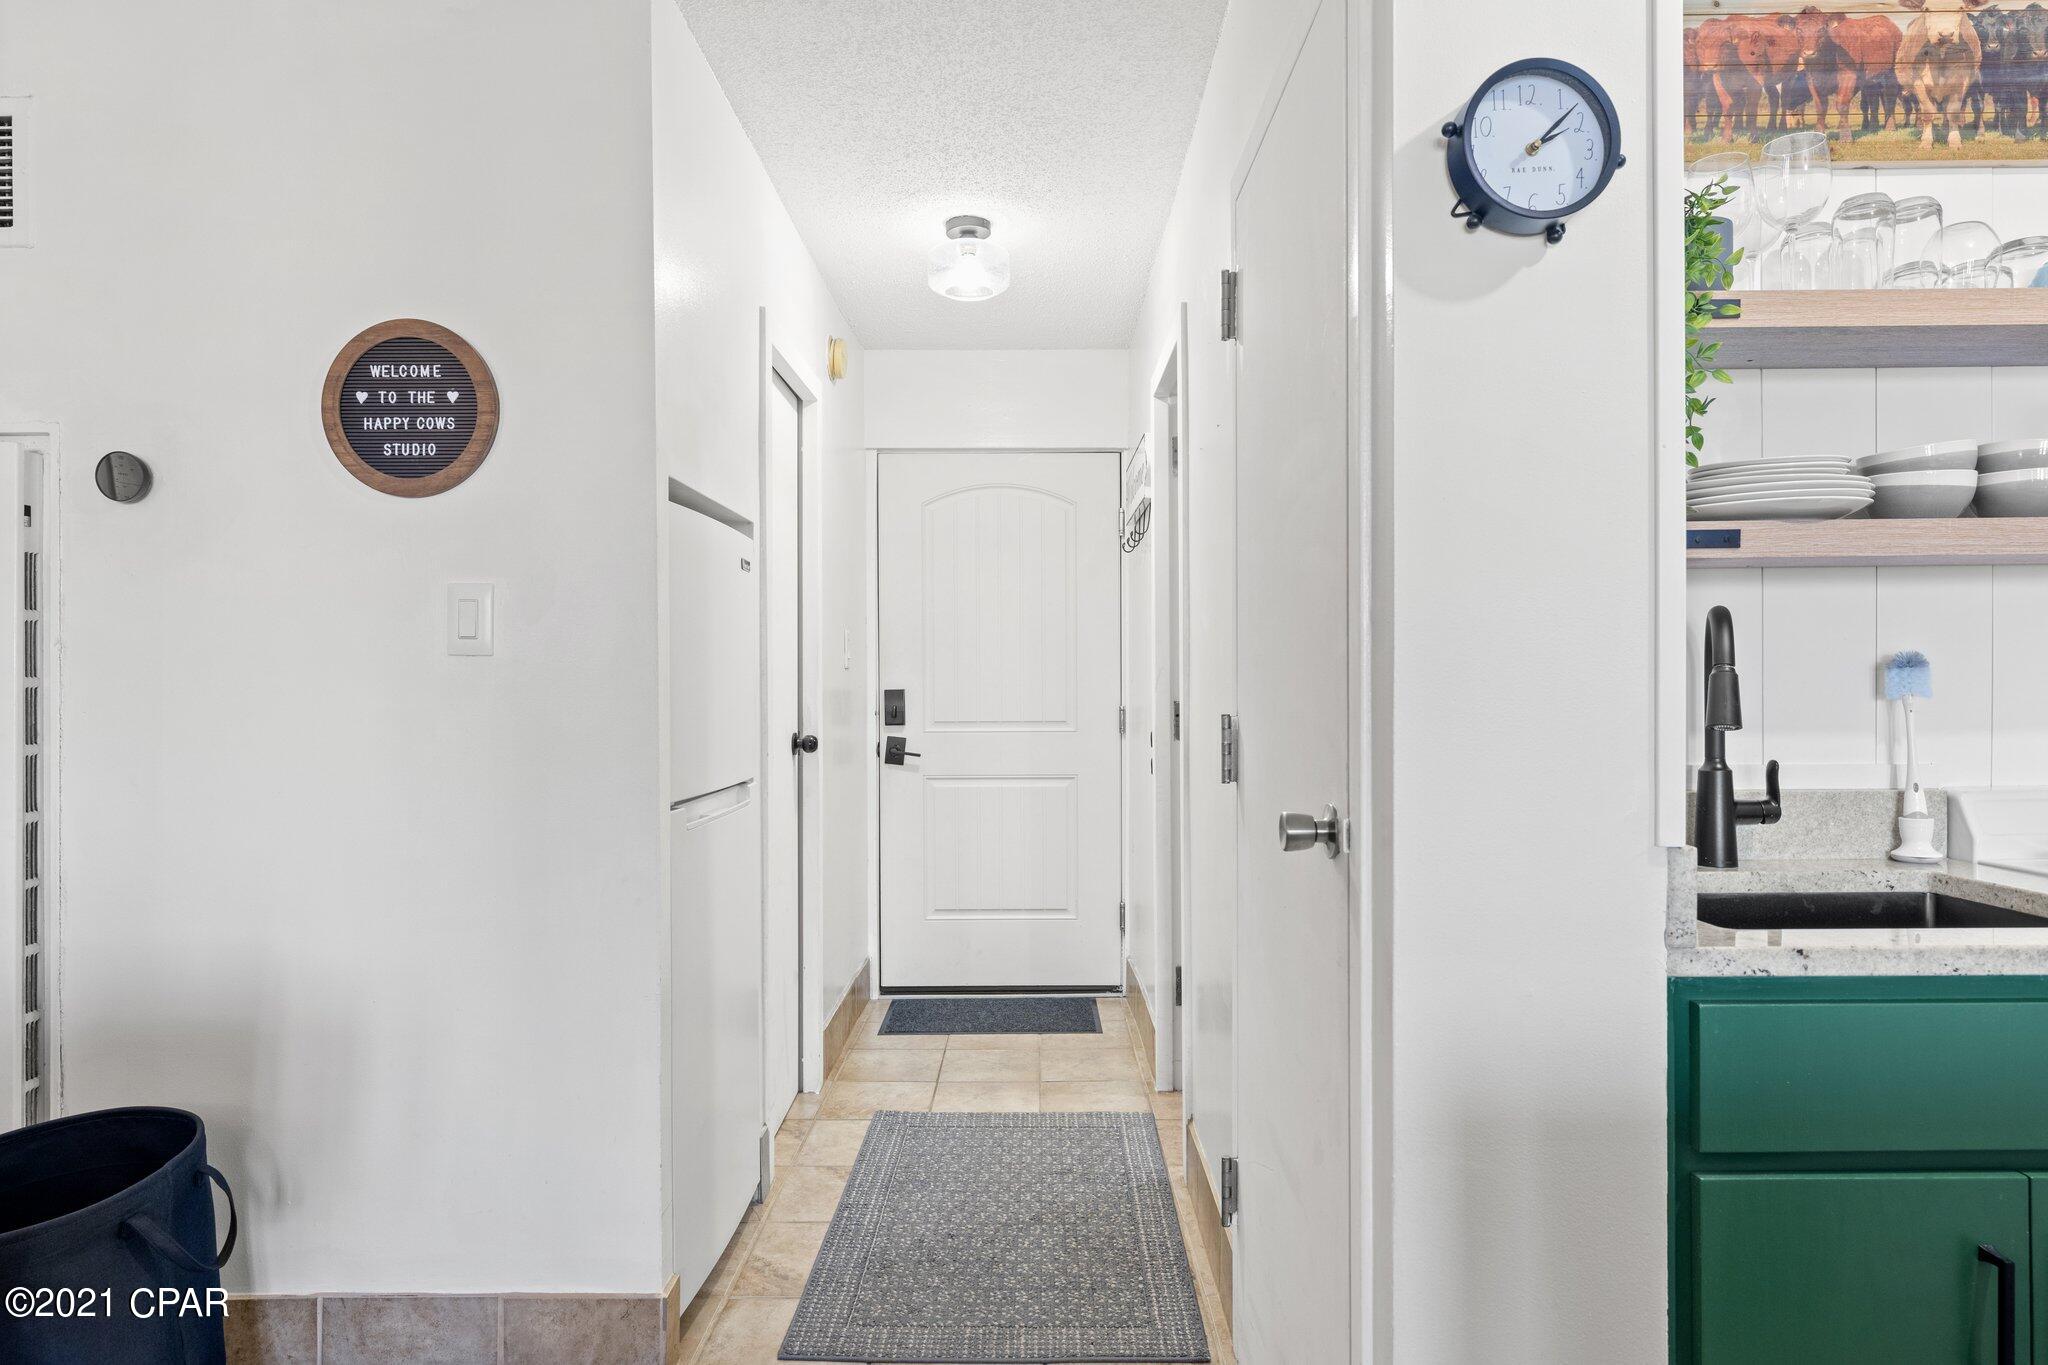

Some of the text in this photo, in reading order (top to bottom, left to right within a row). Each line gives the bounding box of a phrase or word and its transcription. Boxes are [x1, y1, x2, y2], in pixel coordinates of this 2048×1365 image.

[370, 364, 442, 378] WELCOME
[378, 390, 436, 404] TO THE
[363, 416, 456, 431] HAPPY COWS
[383, 443, 437, 456] STUDIO
